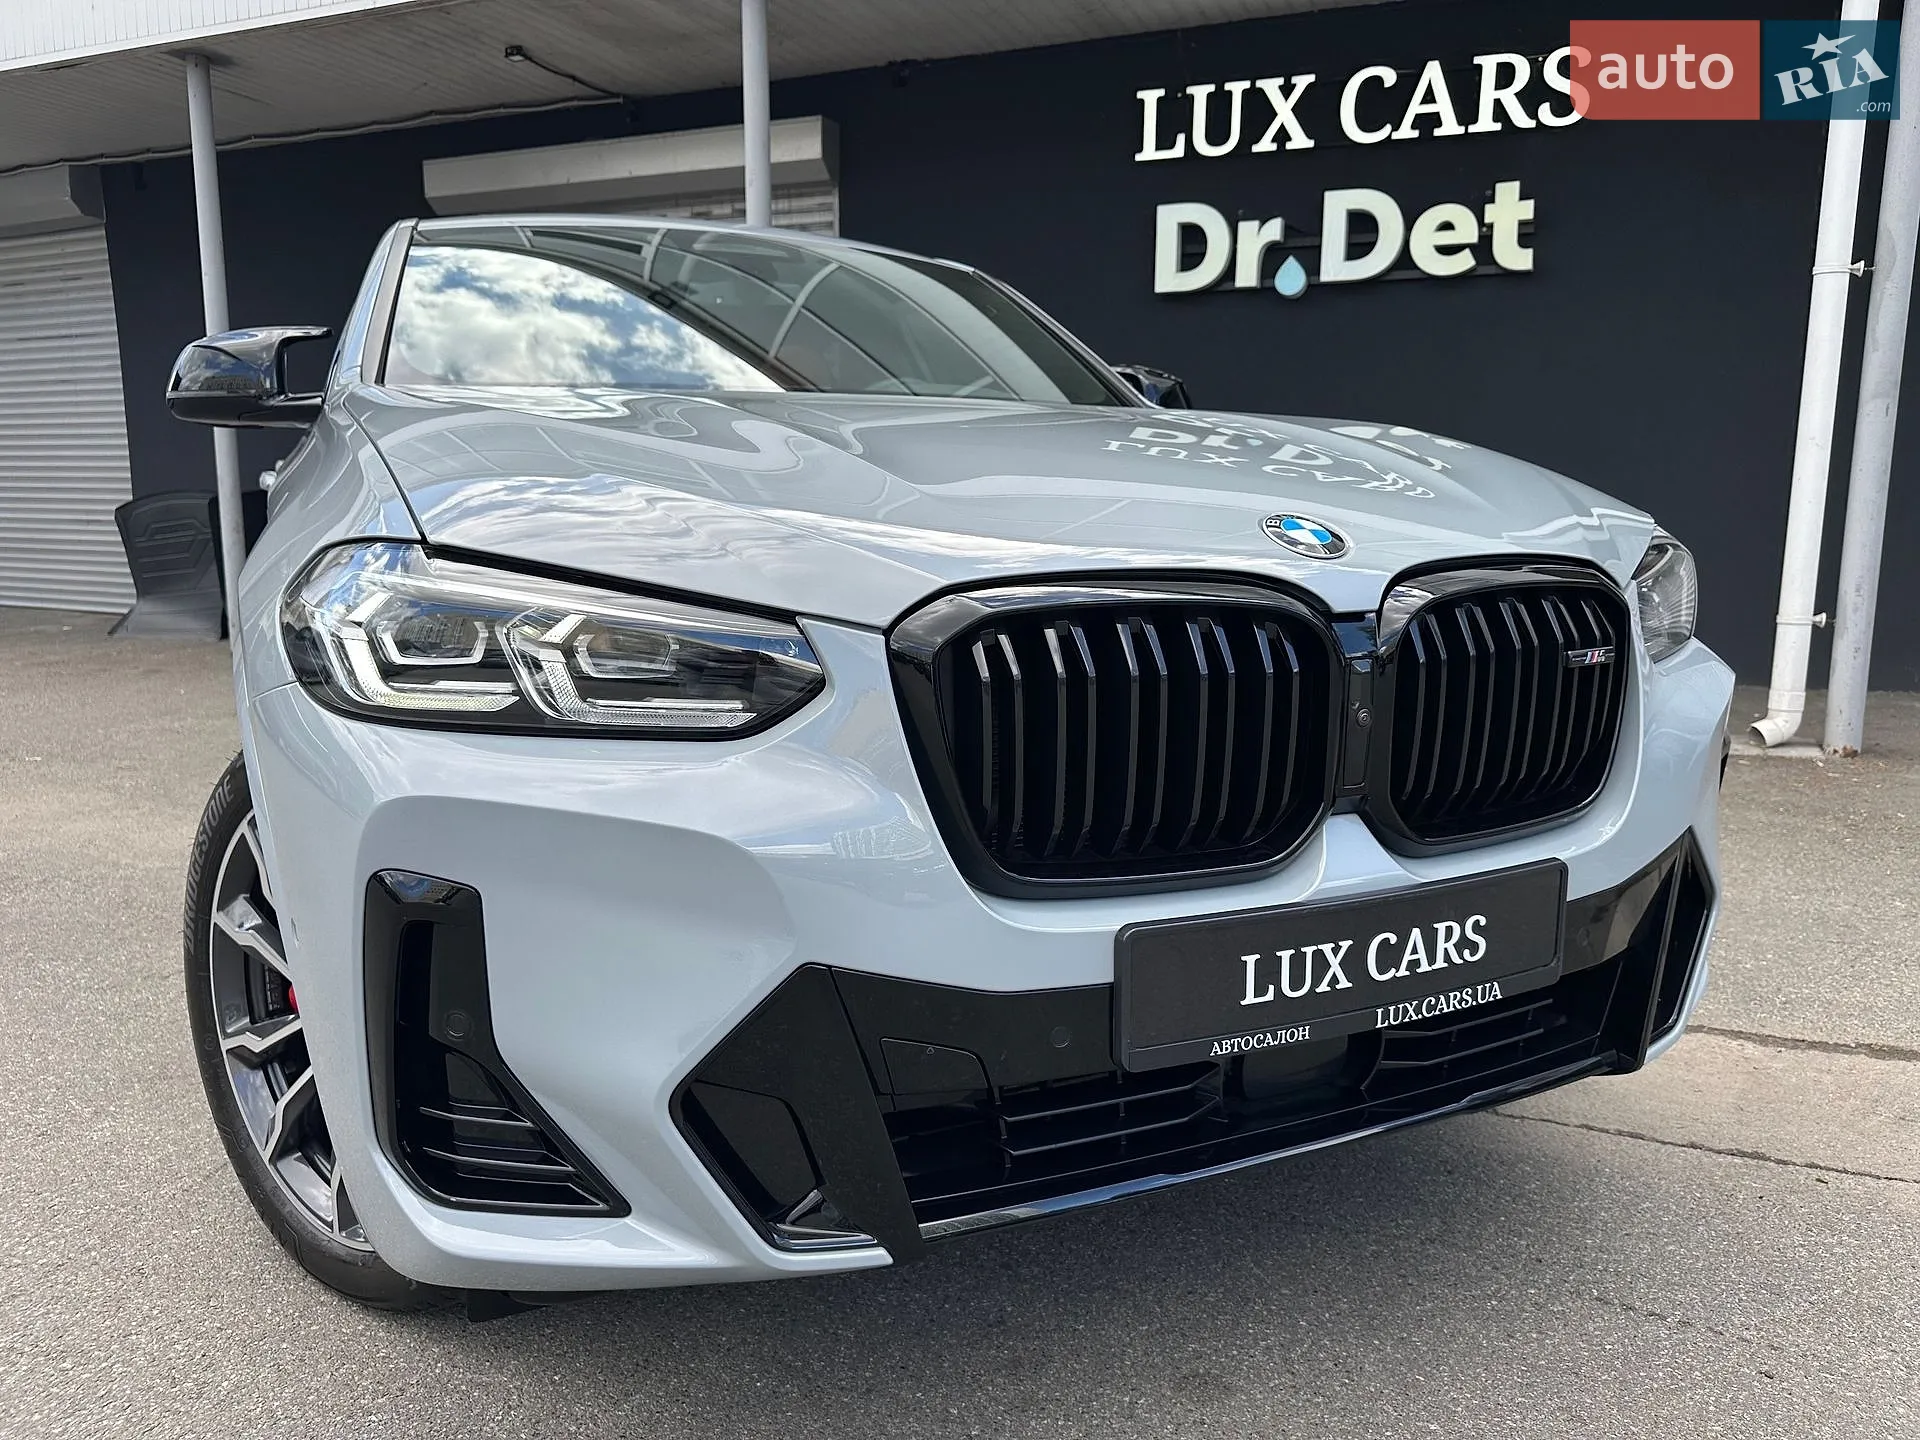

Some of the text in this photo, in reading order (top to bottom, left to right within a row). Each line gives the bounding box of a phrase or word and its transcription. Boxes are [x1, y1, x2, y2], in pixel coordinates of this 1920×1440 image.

[1134, 45, 1592, 162] LUX CARS
[1239, 914, 1488, 1006] LUX CARS
[1375, 981, 1503, 1029] LUX.CARS.UA
[1209, 1025, 1311, 1057] АВТОСАЛОН
